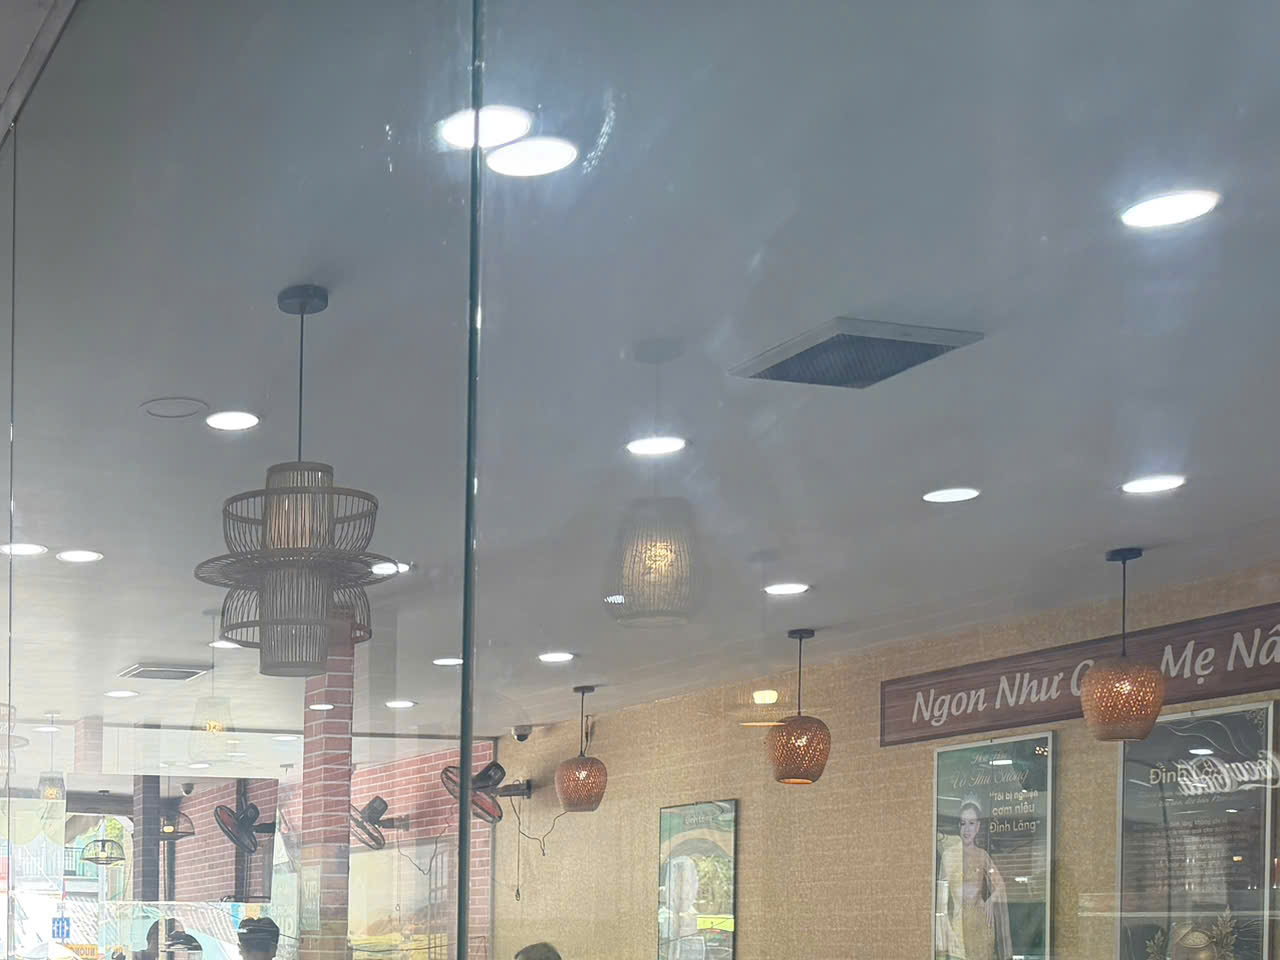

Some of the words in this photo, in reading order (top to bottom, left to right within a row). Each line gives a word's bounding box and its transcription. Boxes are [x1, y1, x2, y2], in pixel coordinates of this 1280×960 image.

[912, 688, 987, 726] Ngon
[995, 672, 1064, 709] Như
[1160, 640, 1215, 685] Mẹ
